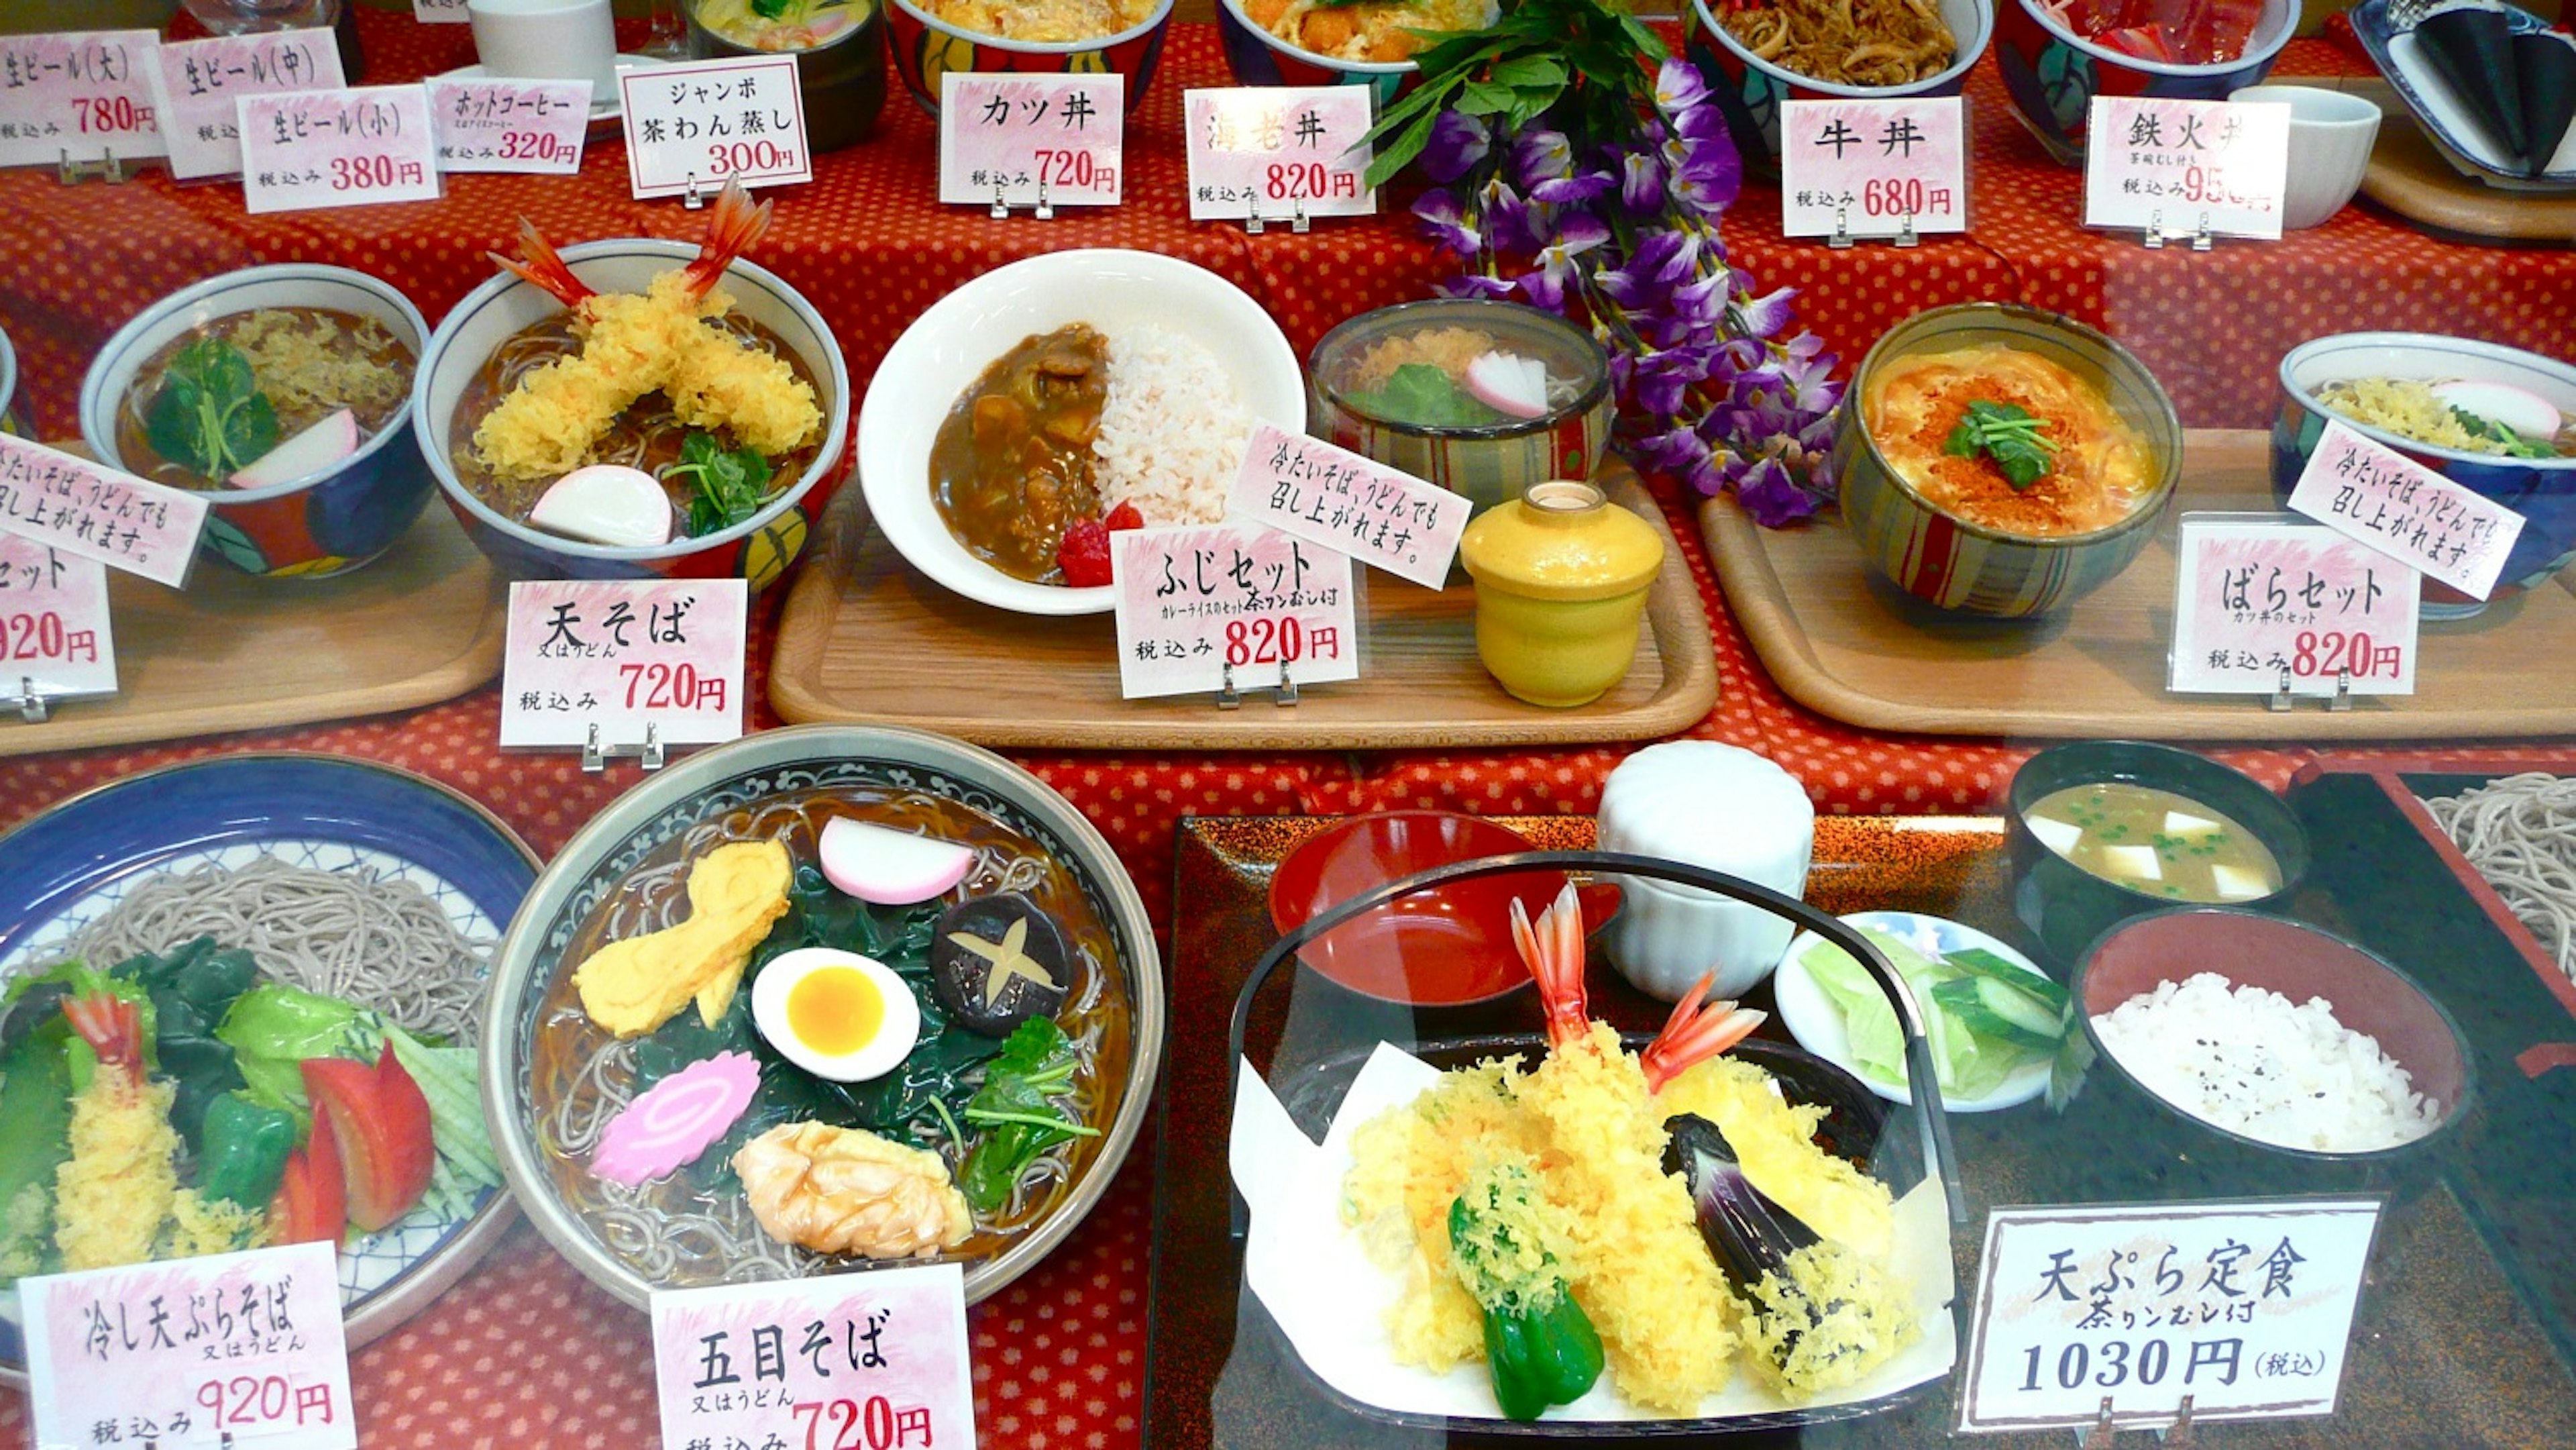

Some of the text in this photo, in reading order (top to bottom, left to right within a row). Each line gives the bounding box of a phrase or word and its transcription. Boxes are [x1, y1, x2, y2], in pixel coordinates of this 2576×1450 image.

[7, 44, 127, 88] 生ビール(大)
[187, 43, 315, 95] 生ビール(中)
[455, 91, 570, 117] ホットコーヒー
[670, 76, 758, 105] ジャンボ
[980, 91, 1097, 131] カツ丼
[1, 97, 157, 138] 税込み 780円
[274, 102, 400, 145] 生ビール(小)
[641, 109, 793, 144] 茶わん蒸し
[1815, 117, 1926, 161] 牛丼
[439, 132, 576, 164] 税込み 320円
[708, 139, 794, 175] 300円
[259, 154, 424, 191] 税込み 380円
[970, 149, 1116, 195] 税込み 720円
[1197, 163, 1355, 202] 税込み 820円
[2123, 178, 2186, 196] 税込み
[1796, 177, 1952, 217] 税込み 680円
[1270, 480, 1418, 565] 召し上がれます。
[1157, 541, 1309, 597] ふじセット
[2223, 563, 2383, 615] ばらセット
[545, 596, 696, 647] 天そば
[1136, 617, 1339, 667] 税込み 820円
[537, 643, 617, 658] 又はうどん
[2207, 631, 2401, 679] 税込み 820円
[519, 663, 725, 713] 税込み 720円
[2033, 1237, 2307, 1303] 天ぷら定食
[84, 1274, 294, 1362] 冷し天ぷらそば
[203, 1335, 306, 1360] 又はうどん
[693, 1307, 892, 1389] 五目そば
[2018, 1337, 2326, 1392] 1030円 (税込)
[91, 1375, 333, 1445] 税込み 920円
[692, 1388, 795, 1413] 又はうどん
[792, 1395, 933, 1450] 720円
